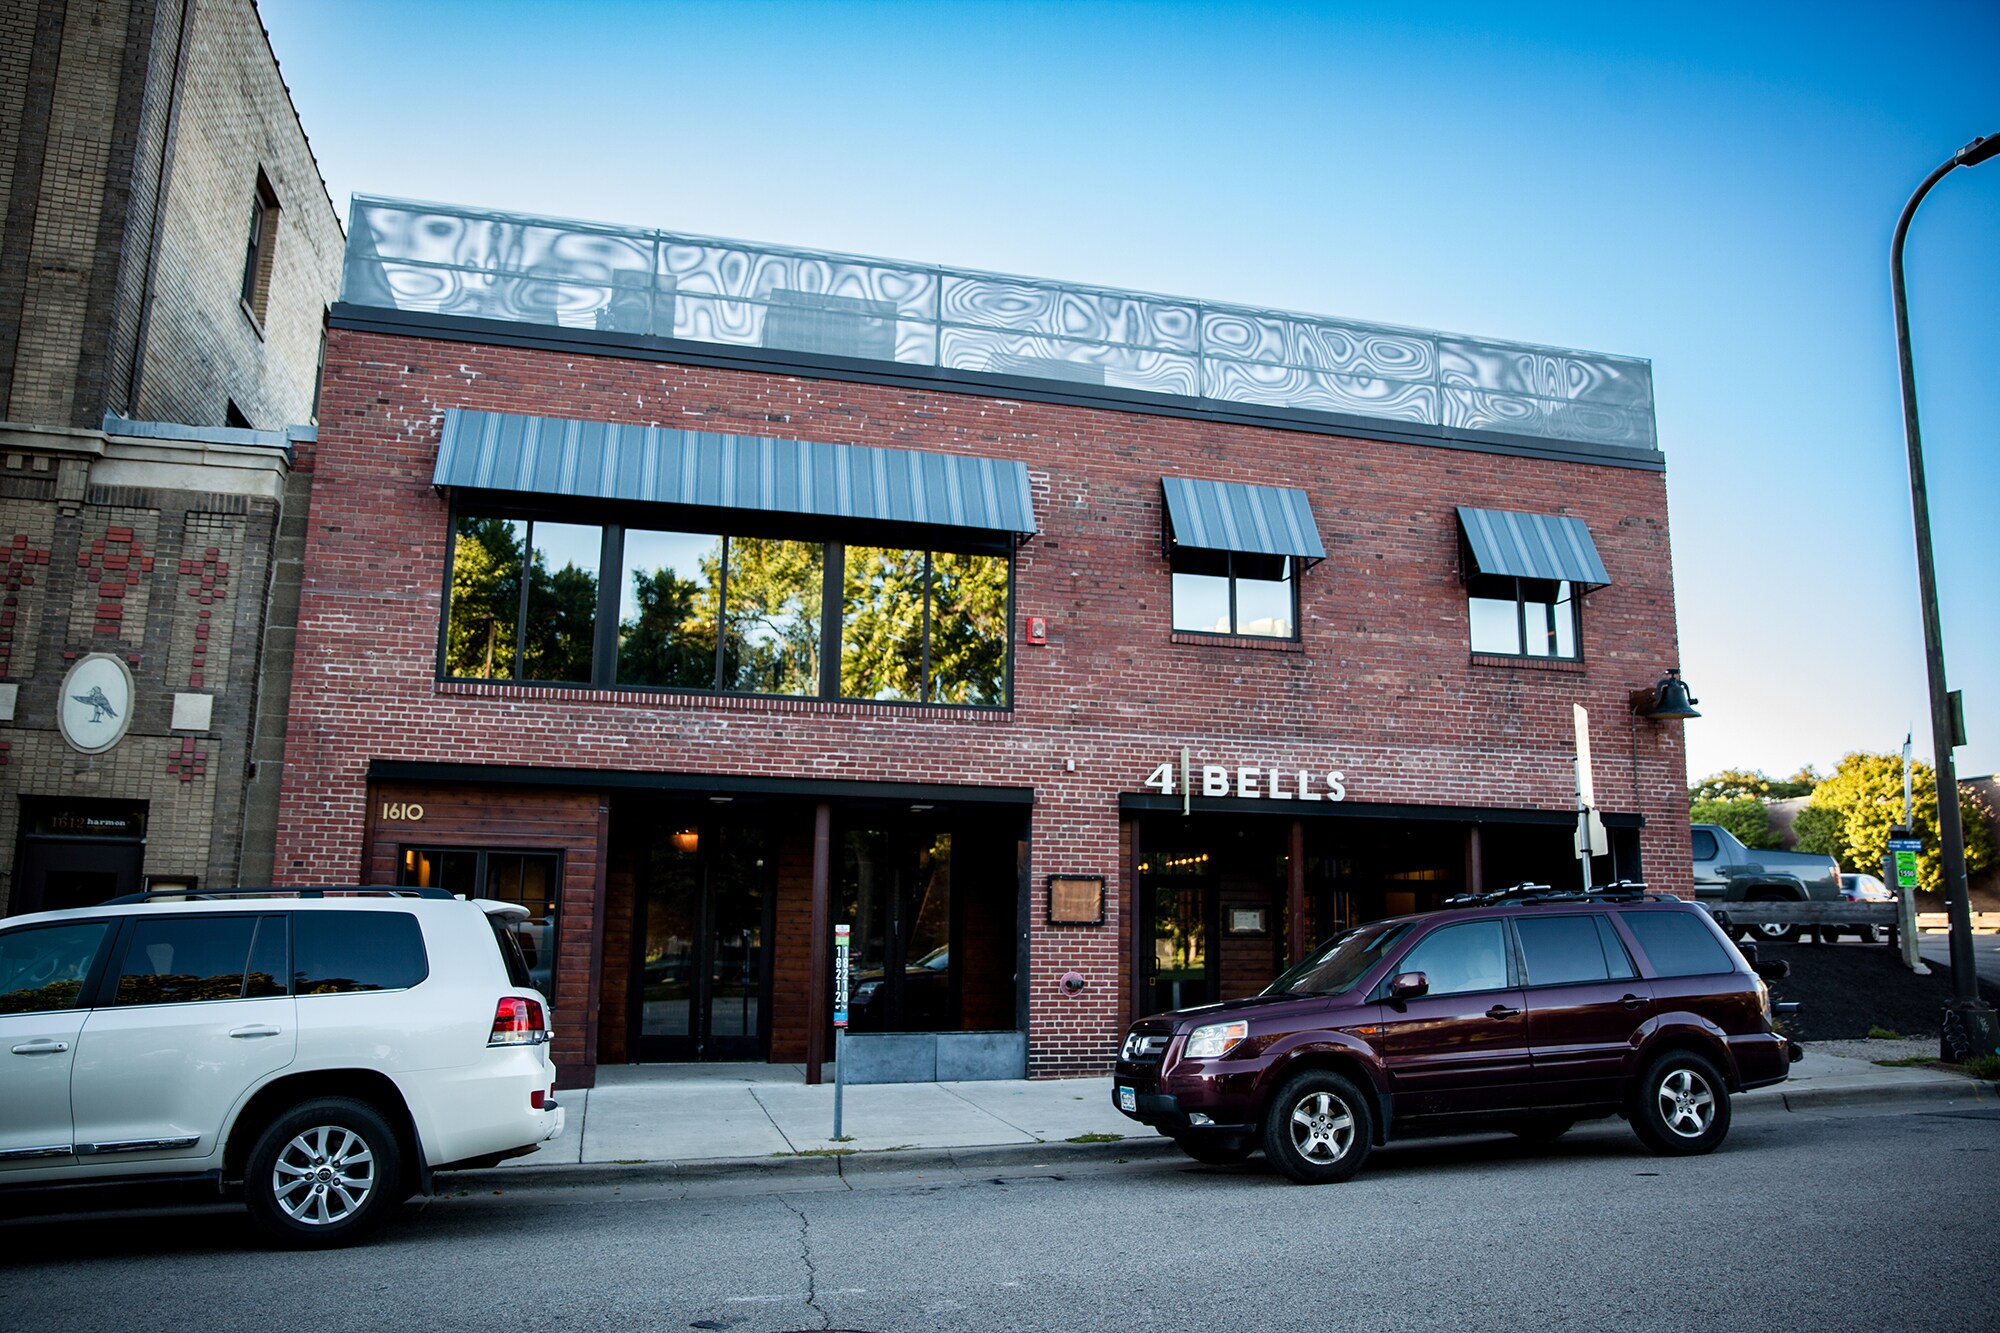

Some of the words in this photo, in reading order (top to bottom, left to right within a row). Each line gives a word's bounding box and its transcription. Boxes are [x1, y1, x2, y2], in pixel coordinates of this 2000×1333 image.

[1144, 763, 1176, 795] 4
[1203, 765, 1346, 802] BELLS
[383, 803, 424, 820] 1610
[51, 816, 85, 829] 1612
[87, 818, 126, 827] harmon
